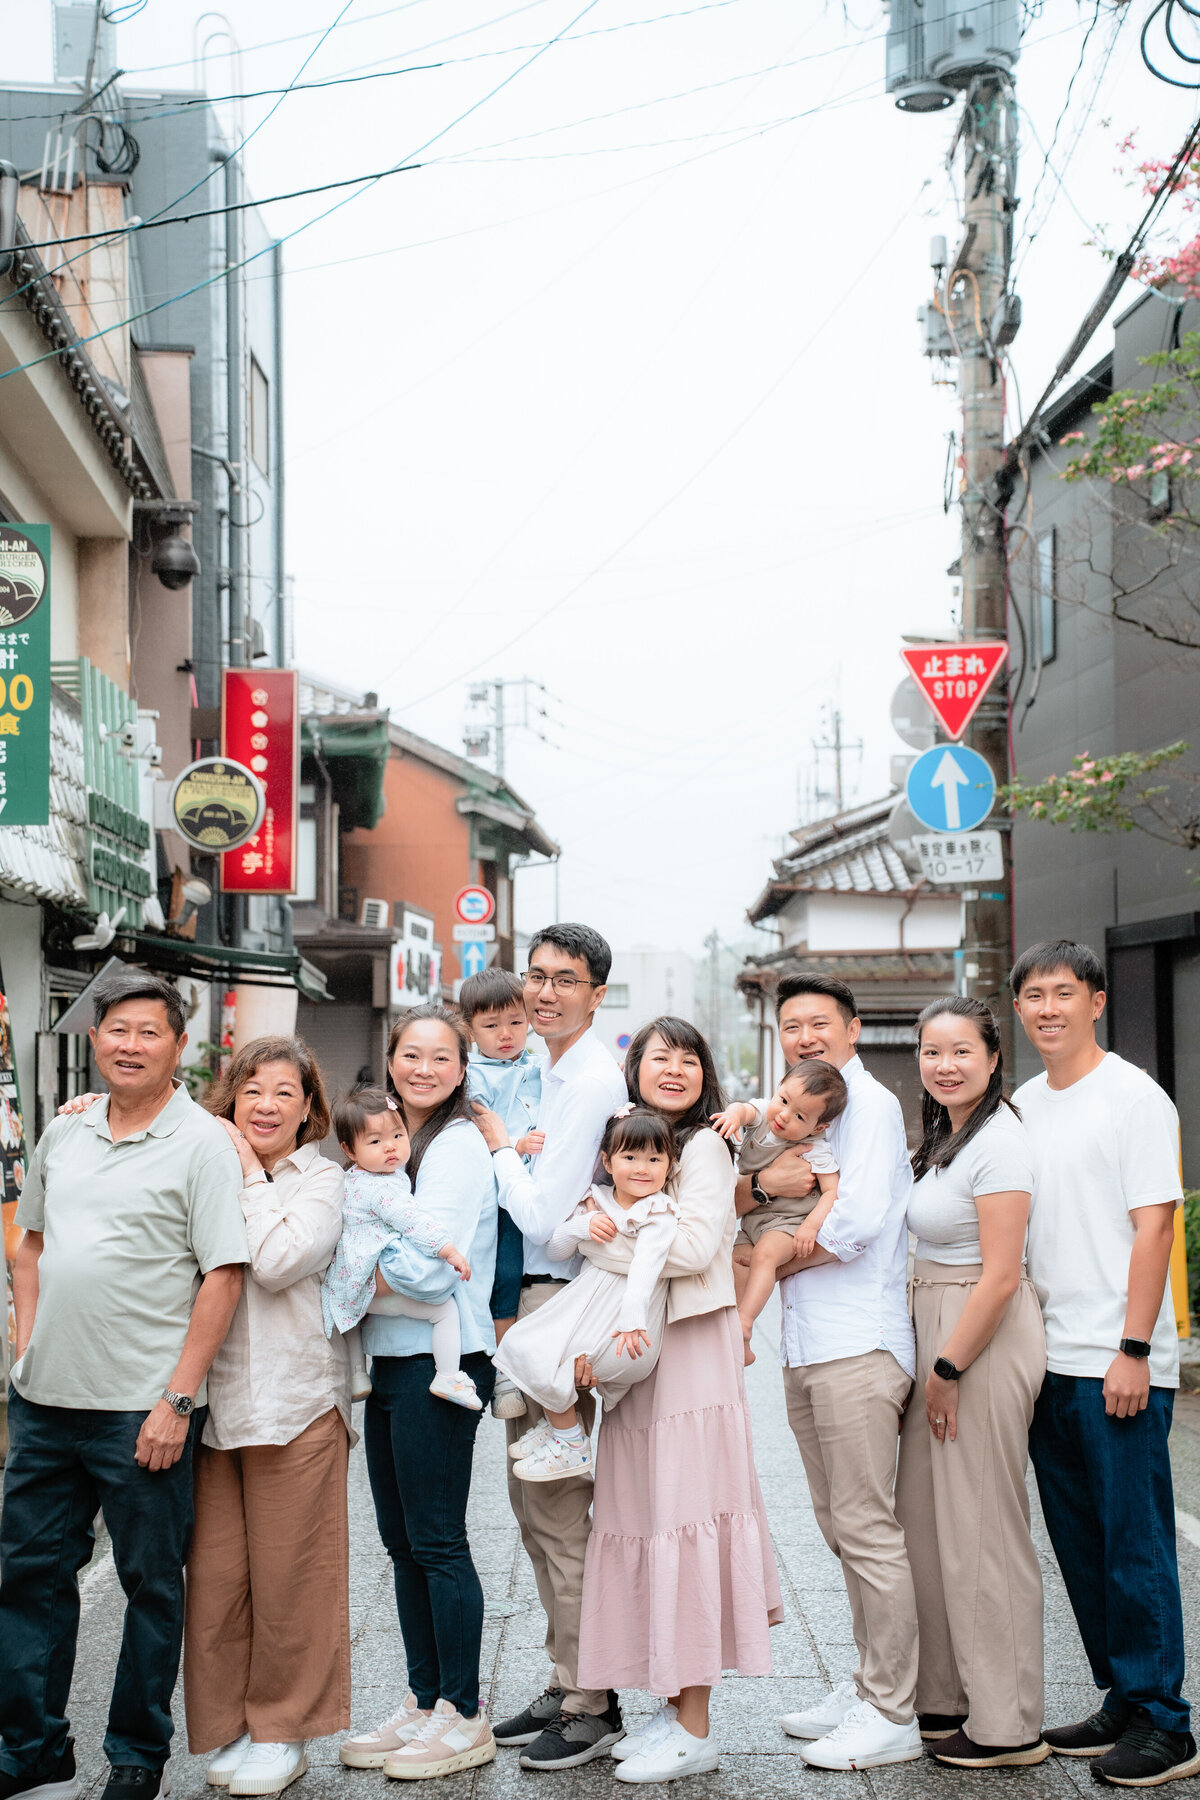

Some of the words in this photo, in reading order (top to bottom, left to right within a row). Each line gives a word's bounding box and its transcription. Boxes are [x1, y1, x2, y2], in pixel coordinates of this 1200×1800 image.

[922, 653, 986, 678] 止まれ
[933, 680, 978, 699] STOP
